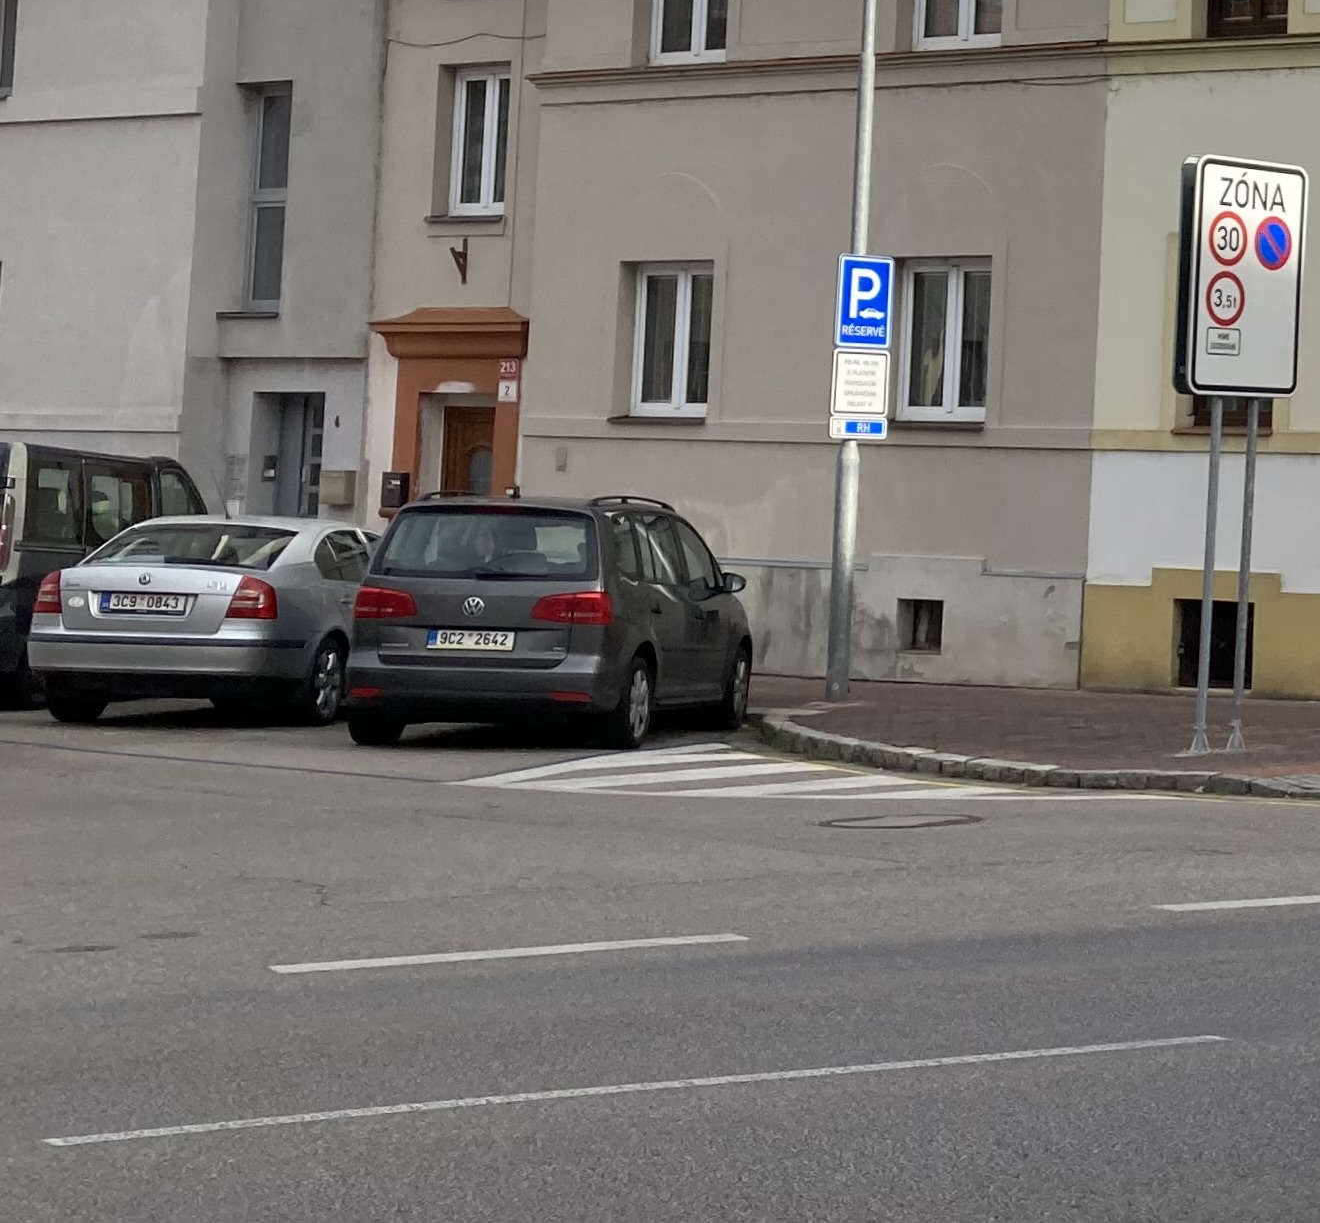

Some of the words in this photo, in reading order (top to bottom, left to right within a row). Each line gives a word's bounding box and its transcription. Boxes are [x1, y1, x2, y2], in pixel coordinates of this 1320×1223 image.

[1219, 171, 1286, 213] ZÓNA
[1217, 225, 1240, 252] 30
[849, 267, 882, 319] P
[1213, 288, 1237, 309] 3,5t
[841, 323, 886, 338] RÉSERVÉ
[500, 361, 517, 373] 213
[504, 385, 510, 396] 2
[856, 422, 870, 433] RH
[112, 594, 137, 608] 3C9
[147, 595, 179, 609] 0843
[439, 632, 464, 645] 9C2
[474, 633, 507, 646] 2642
